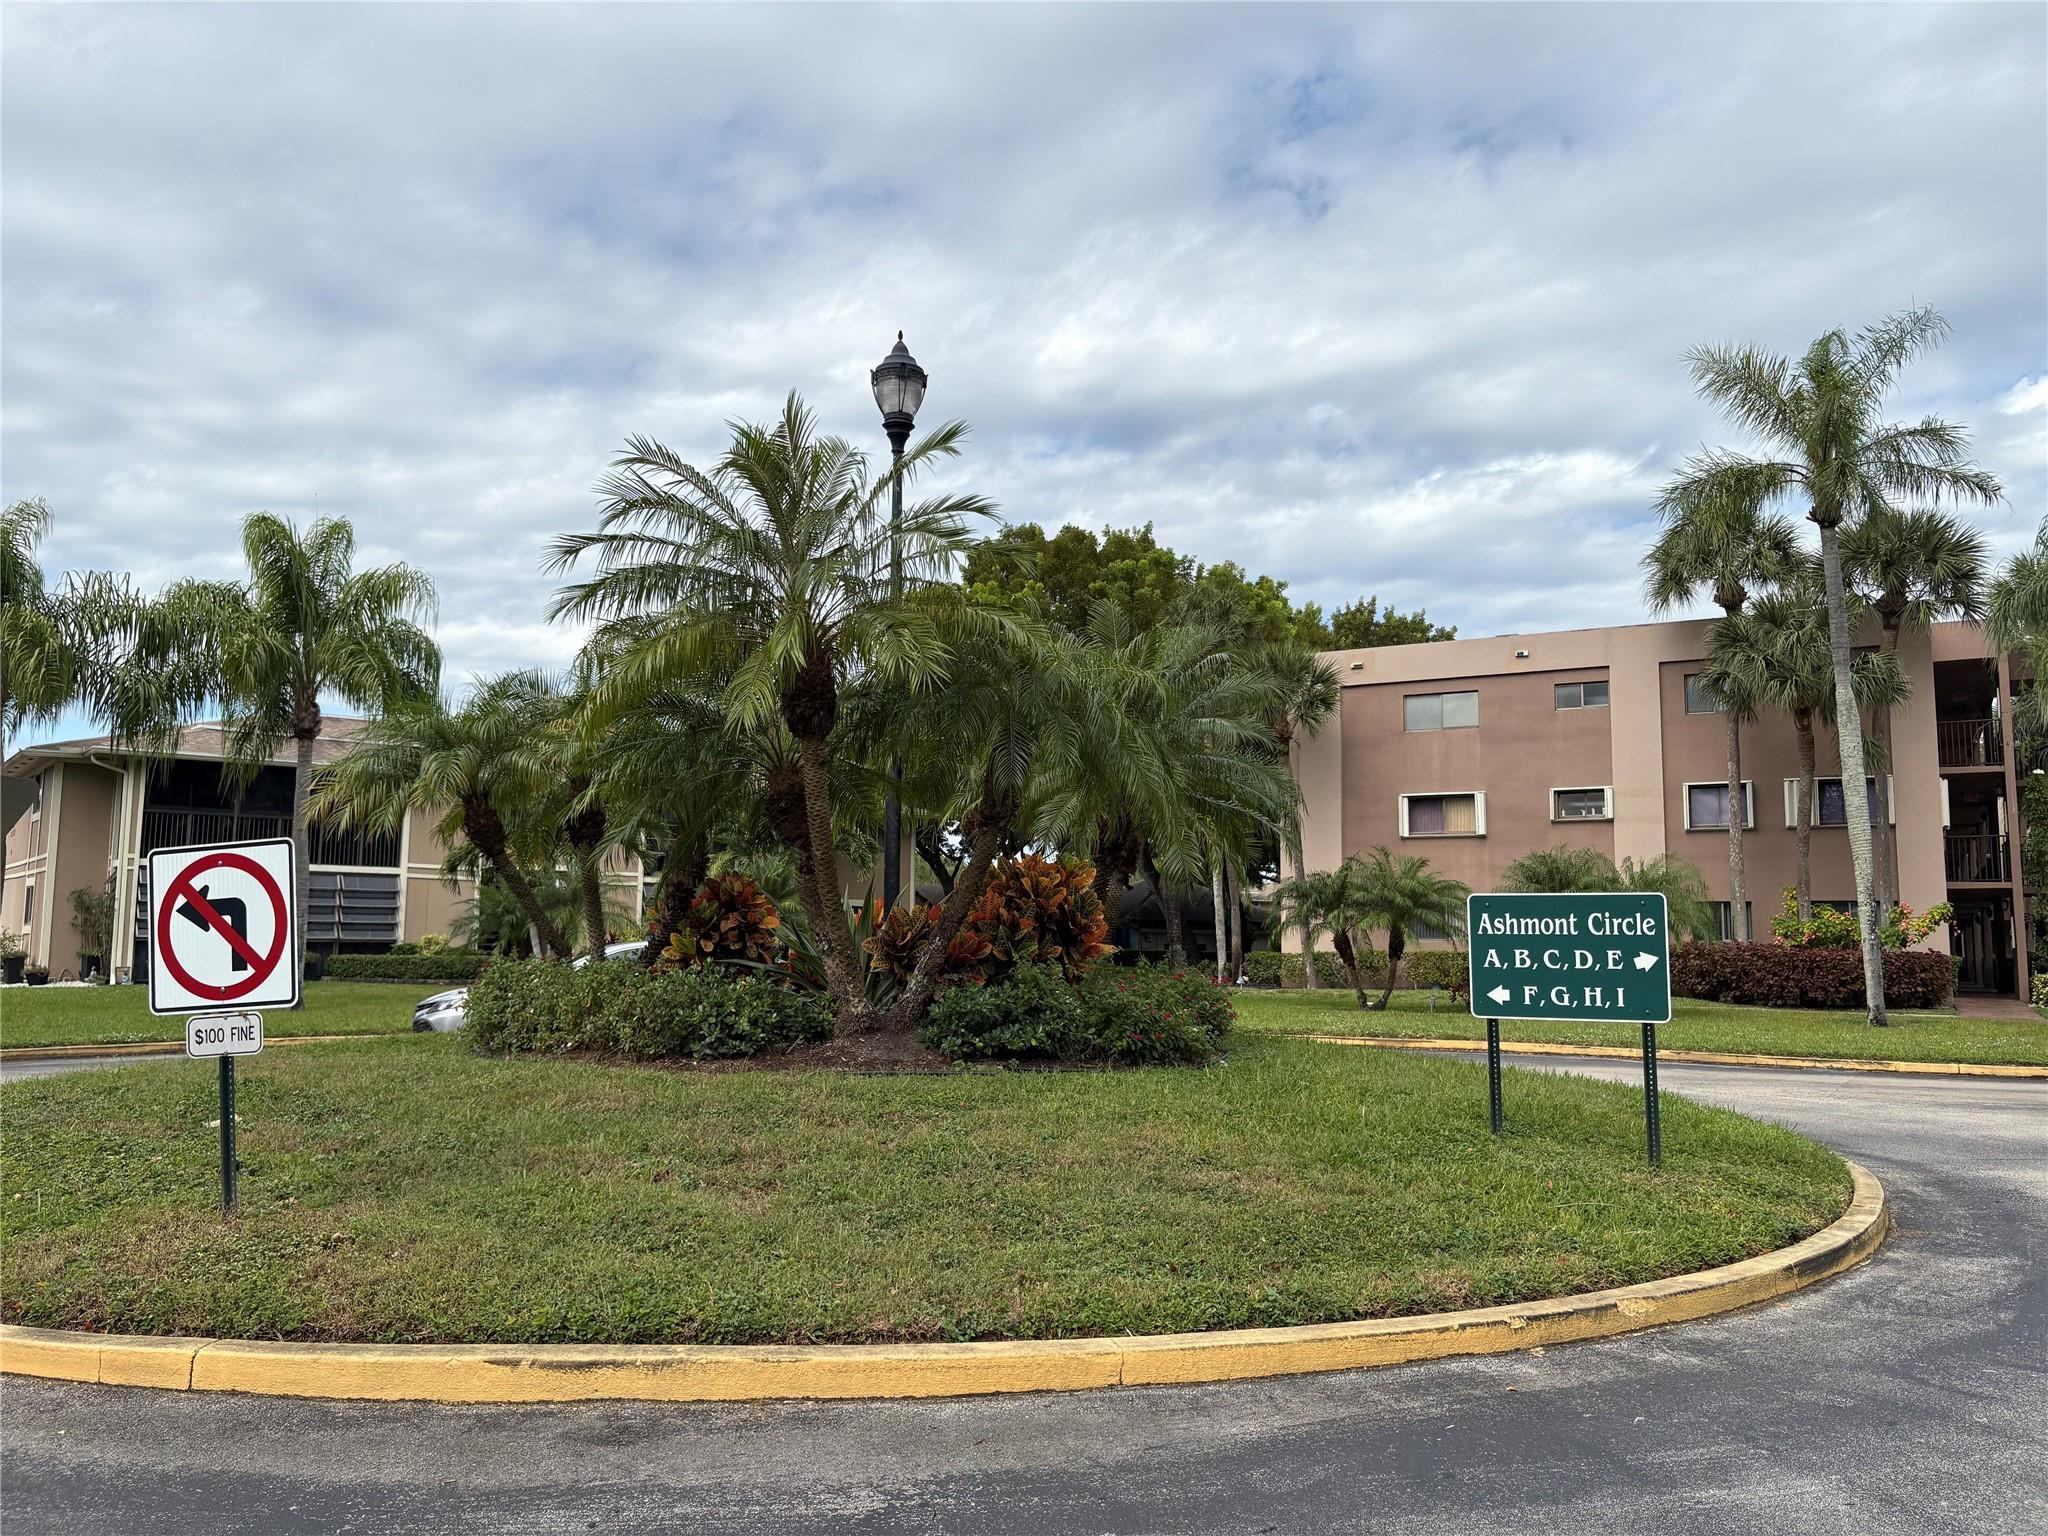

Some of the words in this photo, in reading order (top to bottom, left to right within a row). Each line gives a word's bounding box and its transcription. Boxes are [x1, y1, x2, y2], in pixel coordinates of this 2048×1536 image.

[1477, 912, 1579, 936] Ashmont
[1587, 911, 1656, 936] Circle
[194, 1028, 225, 1045] $100
[230, 1025, 255, 1042] FINE
